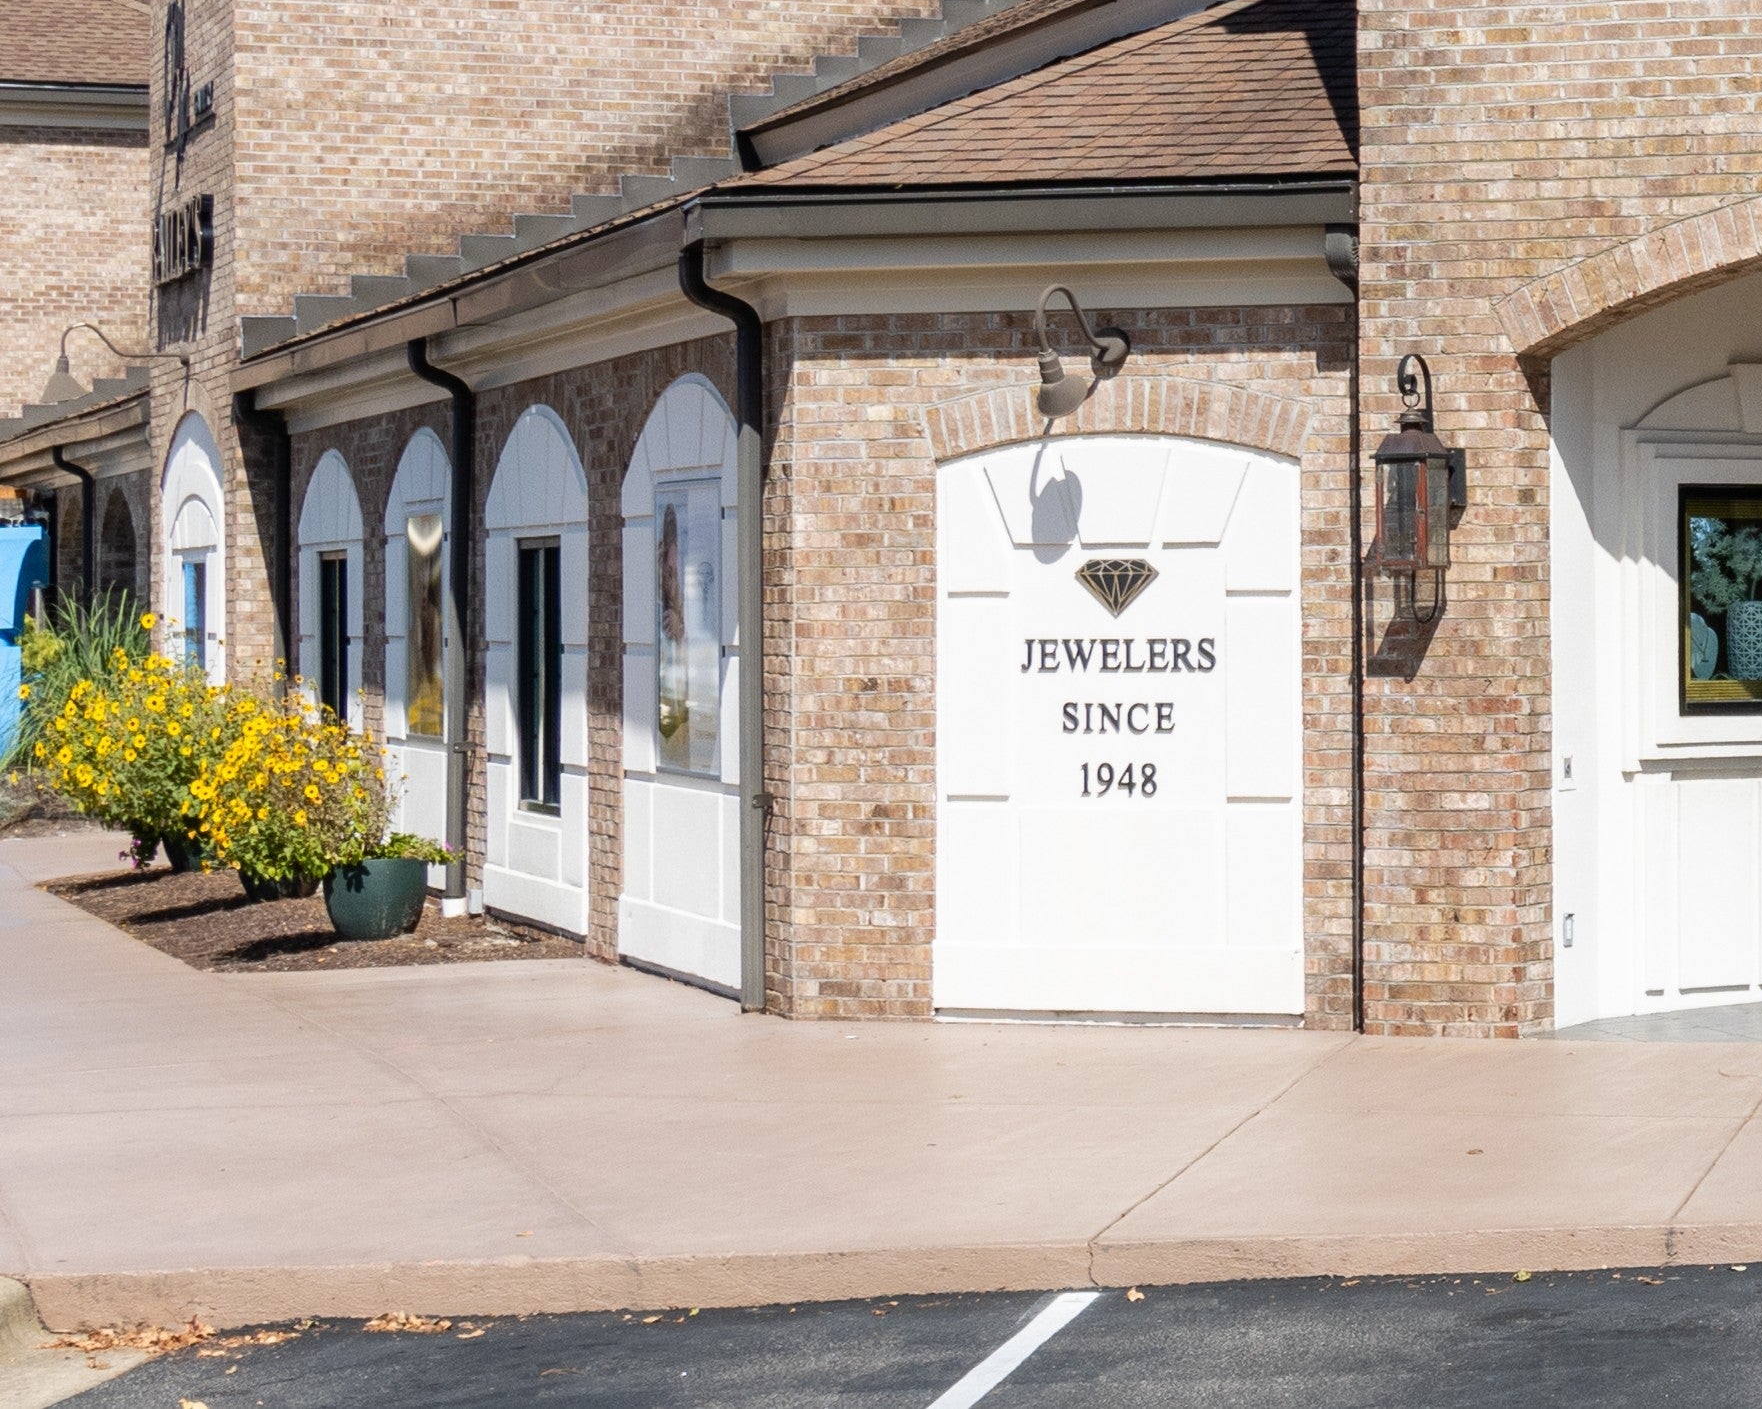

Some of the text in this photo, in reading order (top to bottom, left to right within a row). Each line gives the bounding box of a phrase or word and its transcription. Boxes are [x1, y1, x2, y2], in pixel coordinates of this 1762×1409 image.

[1021, 638, 1217, 673] JEWELERS
[1062, 702, 1176, 735] SINCE
[1081, 762, 1158, 798] 1948
